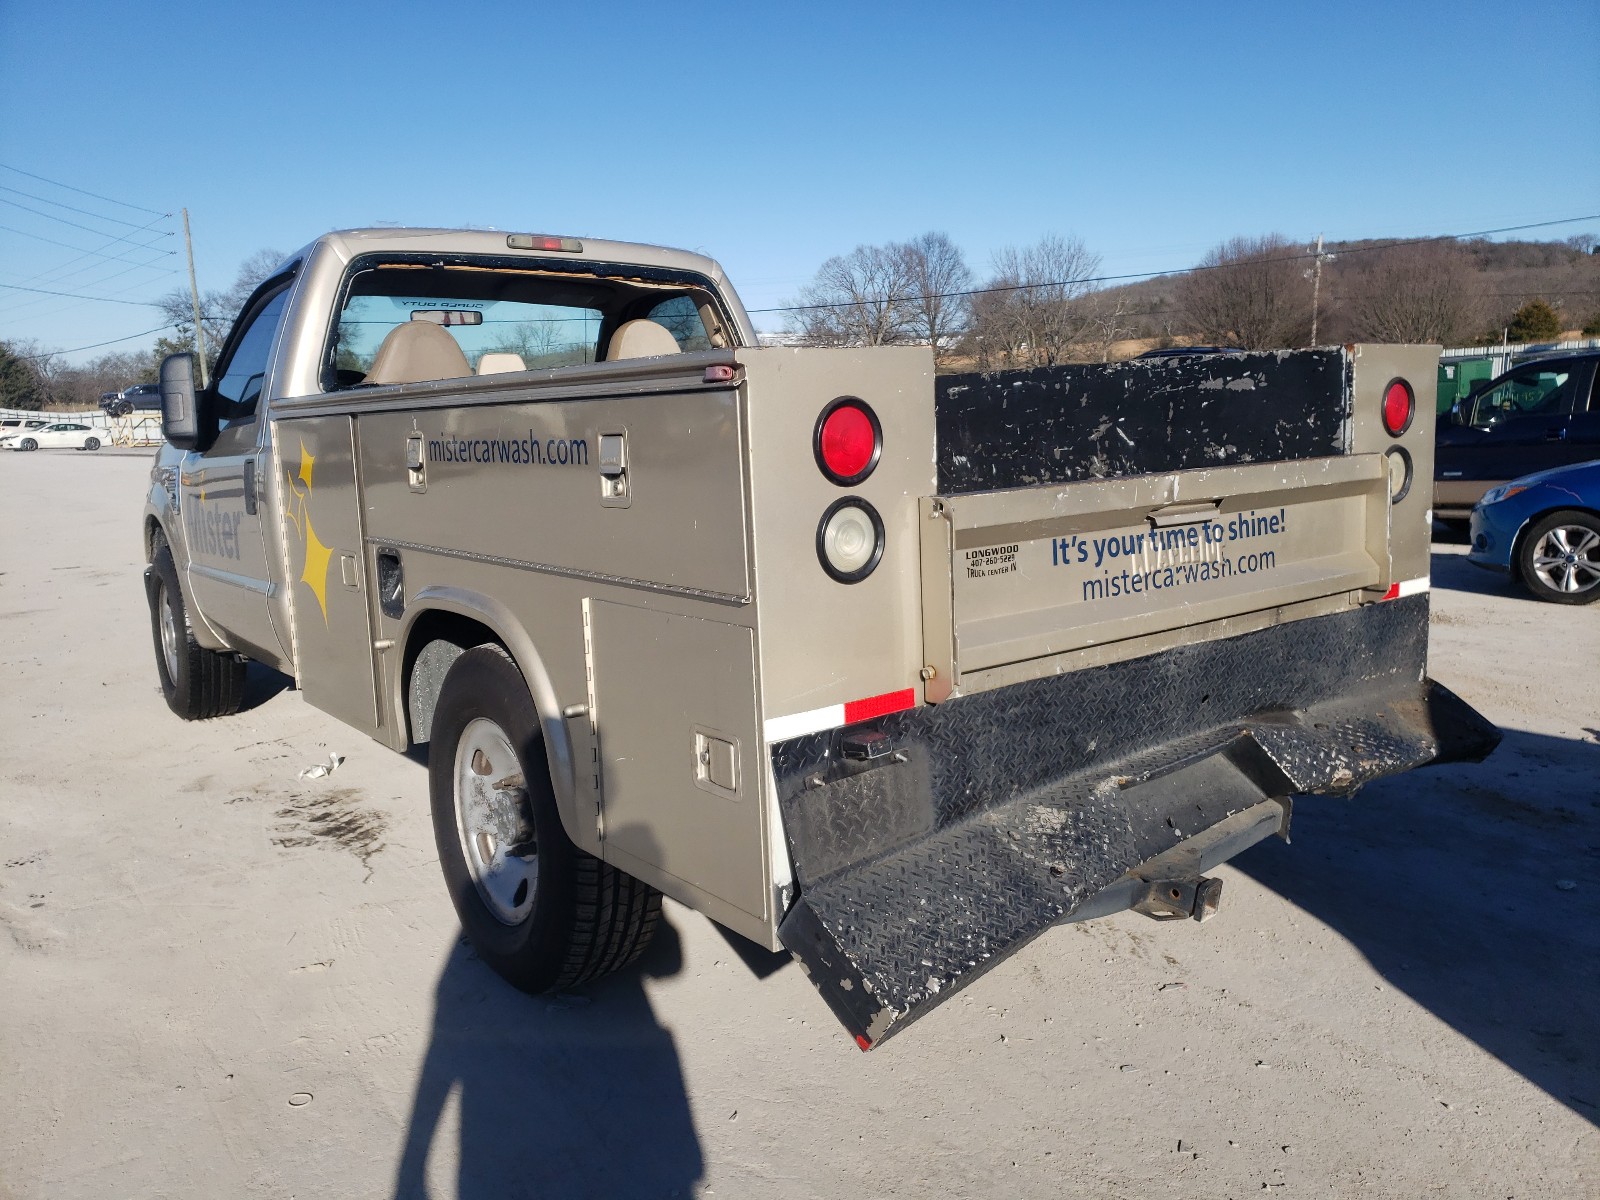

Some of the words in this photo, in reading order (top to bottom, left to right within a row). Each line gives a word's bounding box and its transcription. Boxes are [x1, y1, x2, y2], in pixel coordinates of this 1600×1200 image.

[428, 429, 589, 465] mistercarwash.com
[965, 544, 1019, 560] LONGWOOD
[1052, 535, 1089, 566] It's
[1093, 533, 1145, 567] your
[1148, 527, 1199, 552] time
[1202, 521, 1224, 544] to
[1228, 508, 1286, 541] shine!
[966, 567, 986, 579] TRUCK
[987, 566, 1009, 576] CENTER
[1082, 550, 1276, 601] mistercarwash.com
